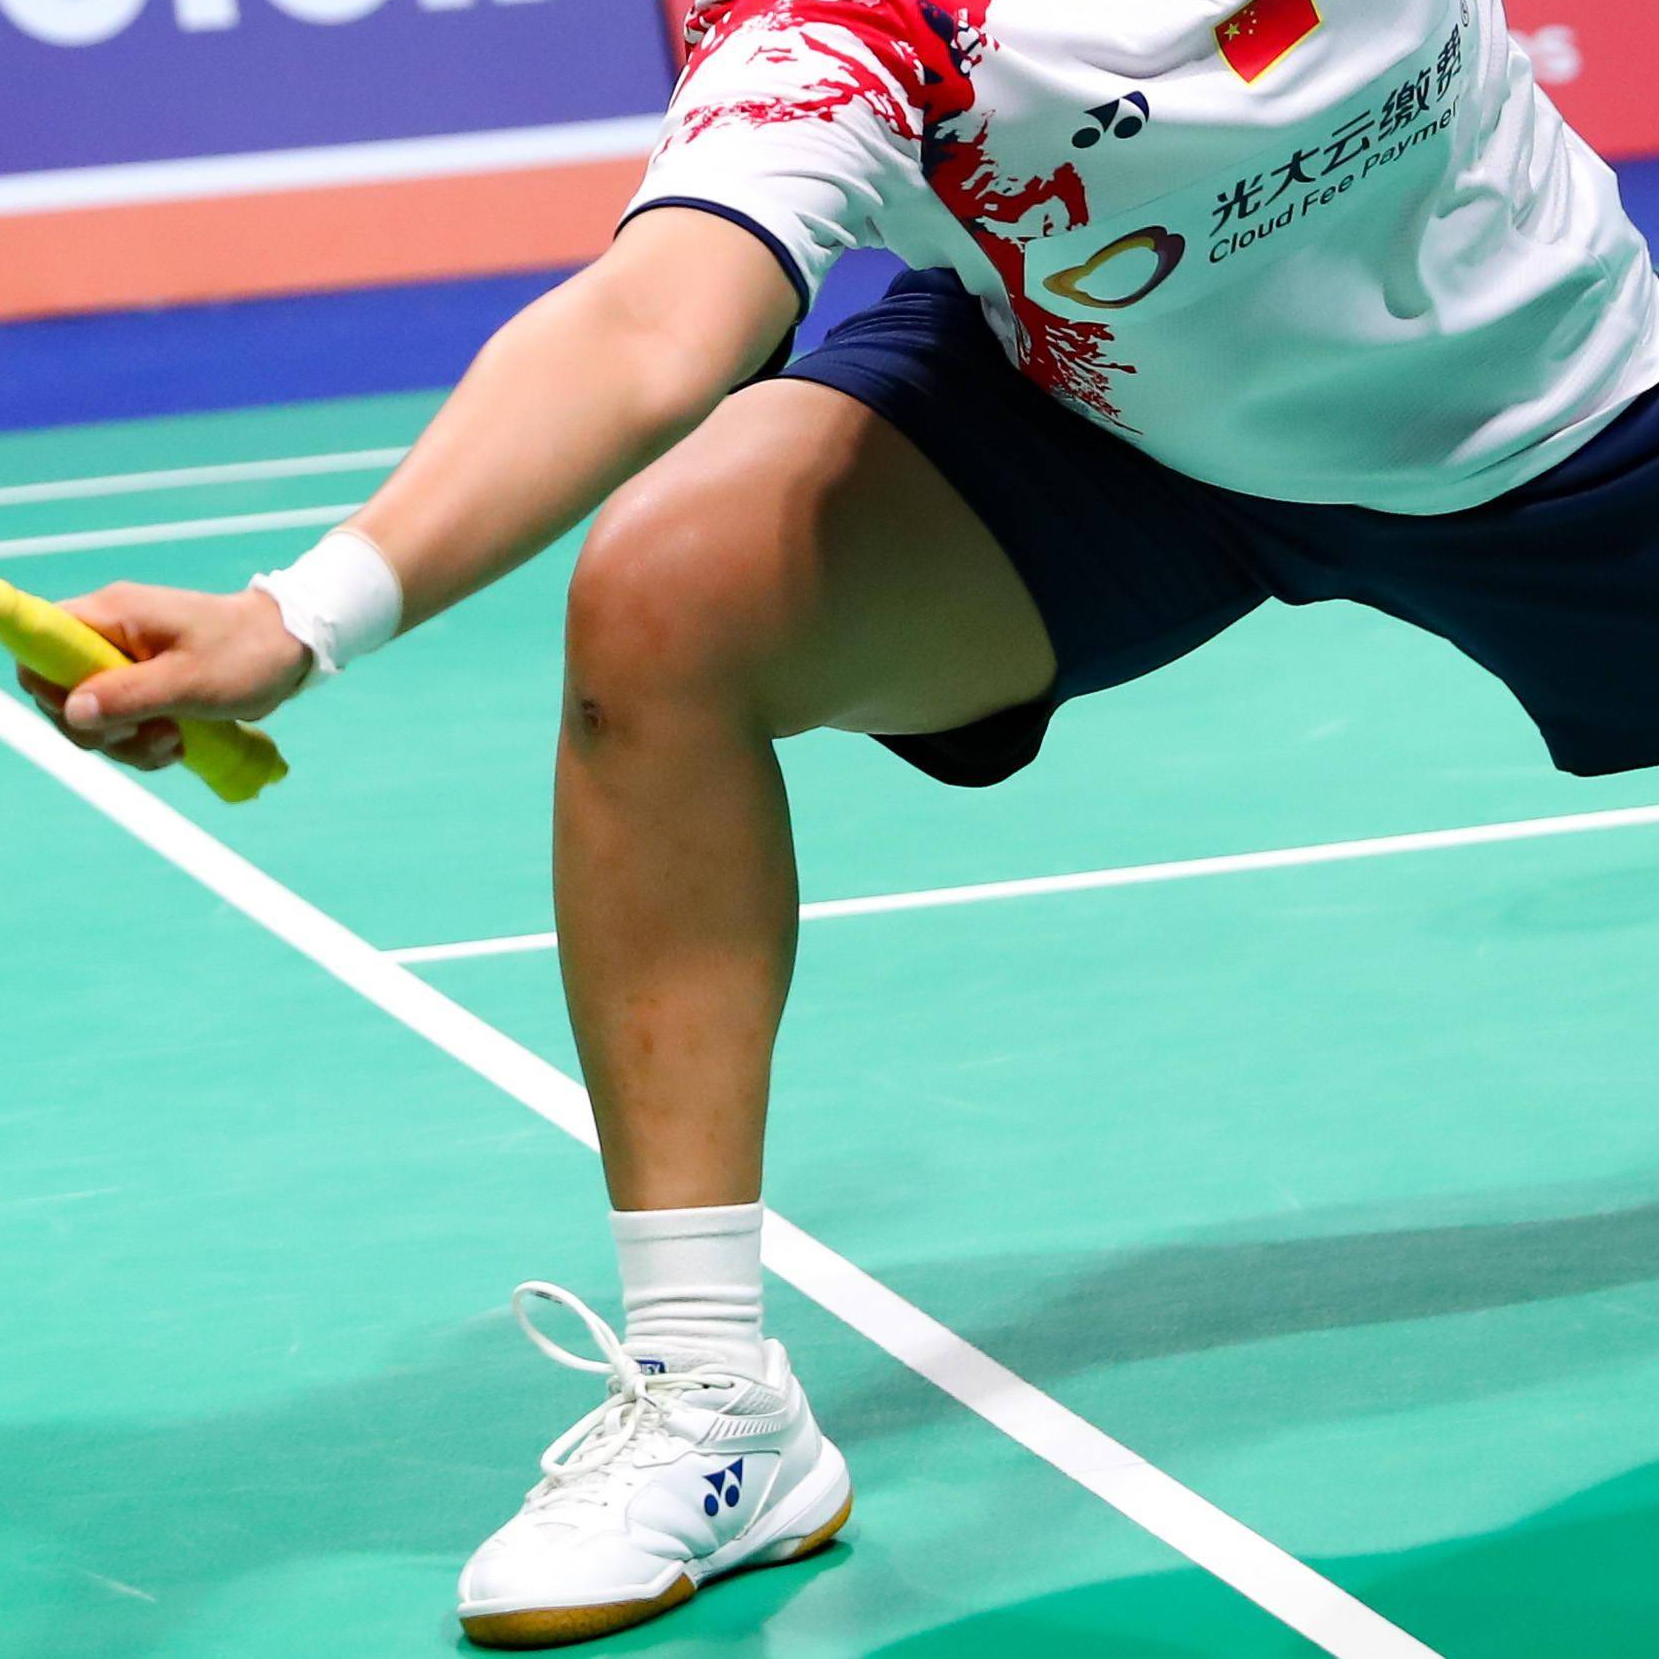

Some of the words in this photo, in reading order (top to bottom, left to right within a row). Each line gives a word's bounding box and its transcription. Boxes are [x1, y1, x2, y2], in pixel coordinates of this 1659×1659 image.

[1208, 204, 1294, 264] Cloud
[1301, 173, 1354, 217] Fee
[1361, 94, 1460, 179] Payme
[1209, 23, 1462, 237] 光大云缴费
